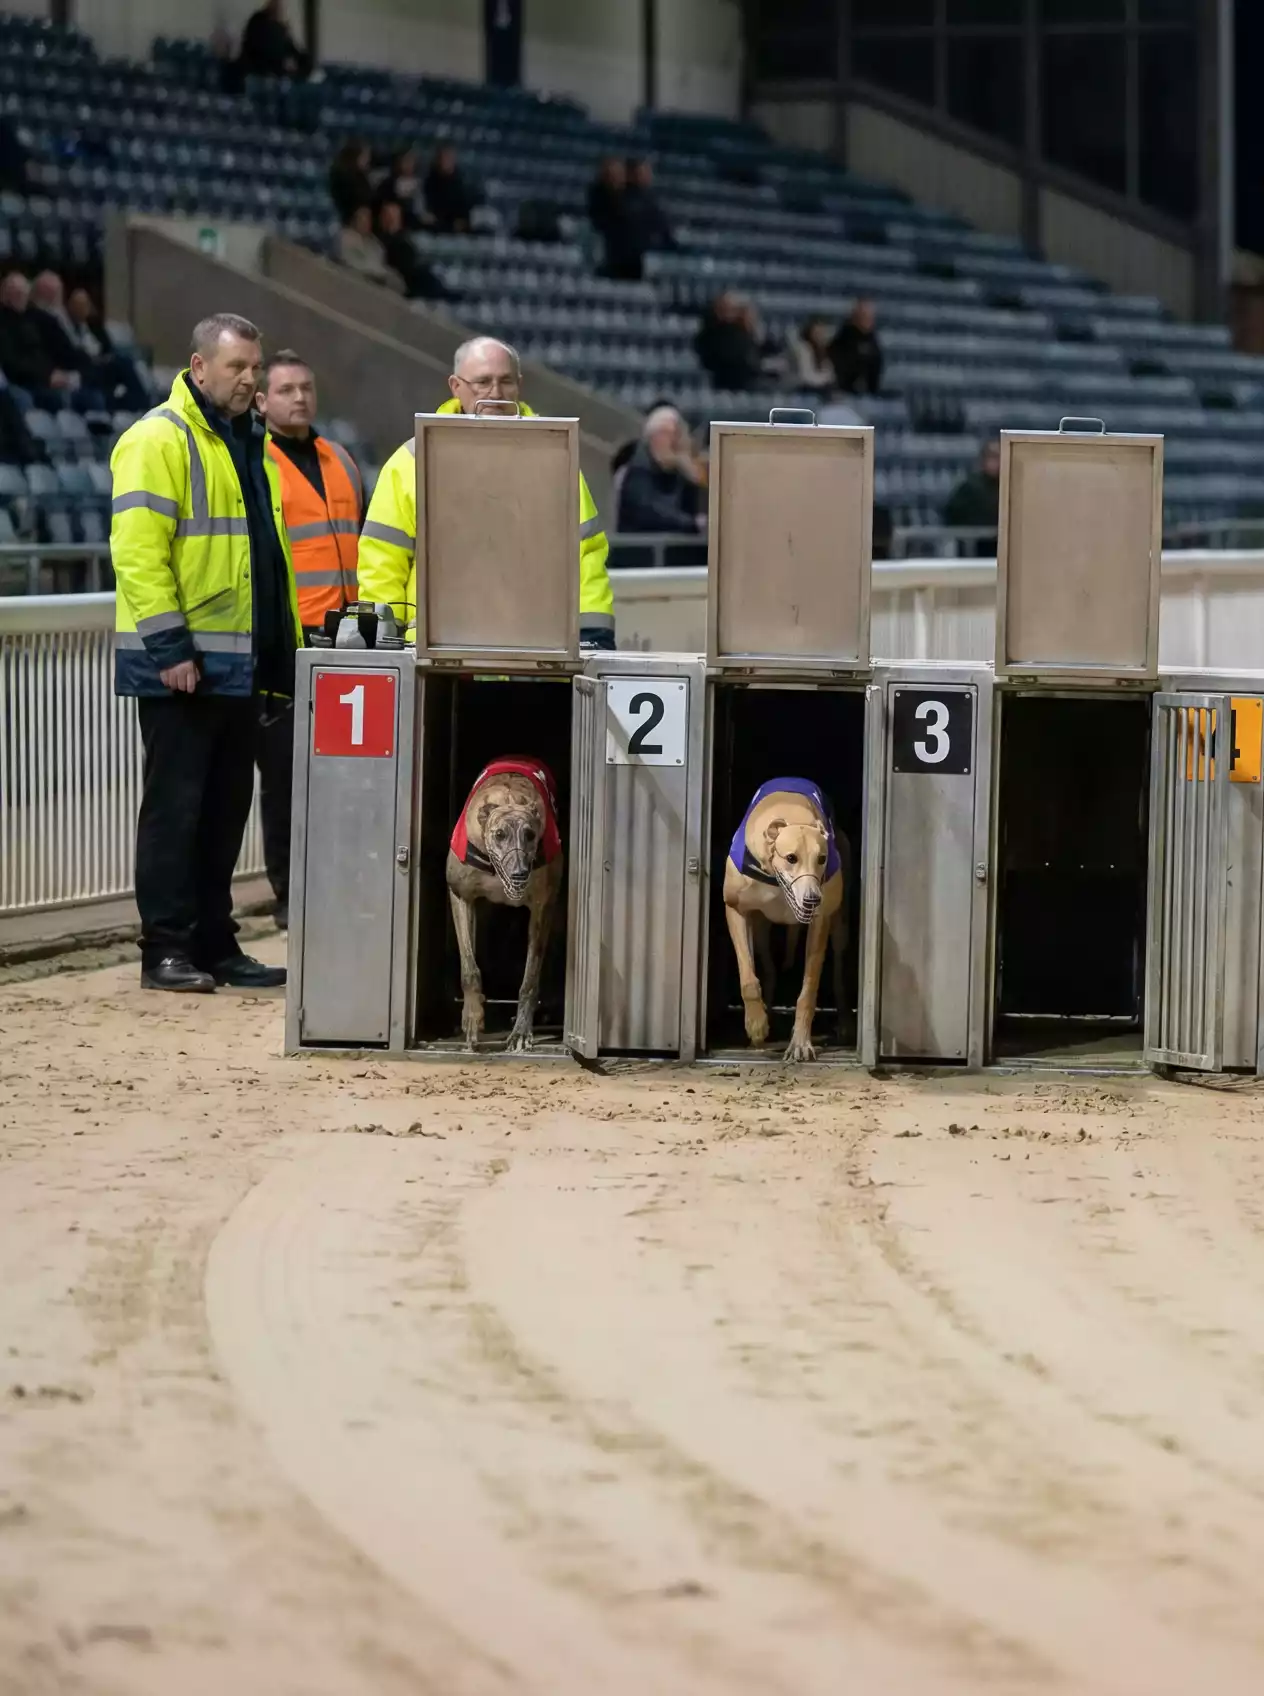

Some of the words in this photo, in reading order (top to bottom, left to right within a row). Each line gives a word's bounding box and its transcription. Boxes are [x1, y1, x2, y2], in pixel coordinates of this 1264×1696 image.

[340, 685, 364, 745] 1
[628, 692, 665, 755] 2
[914, 700, 950, 764] 3
